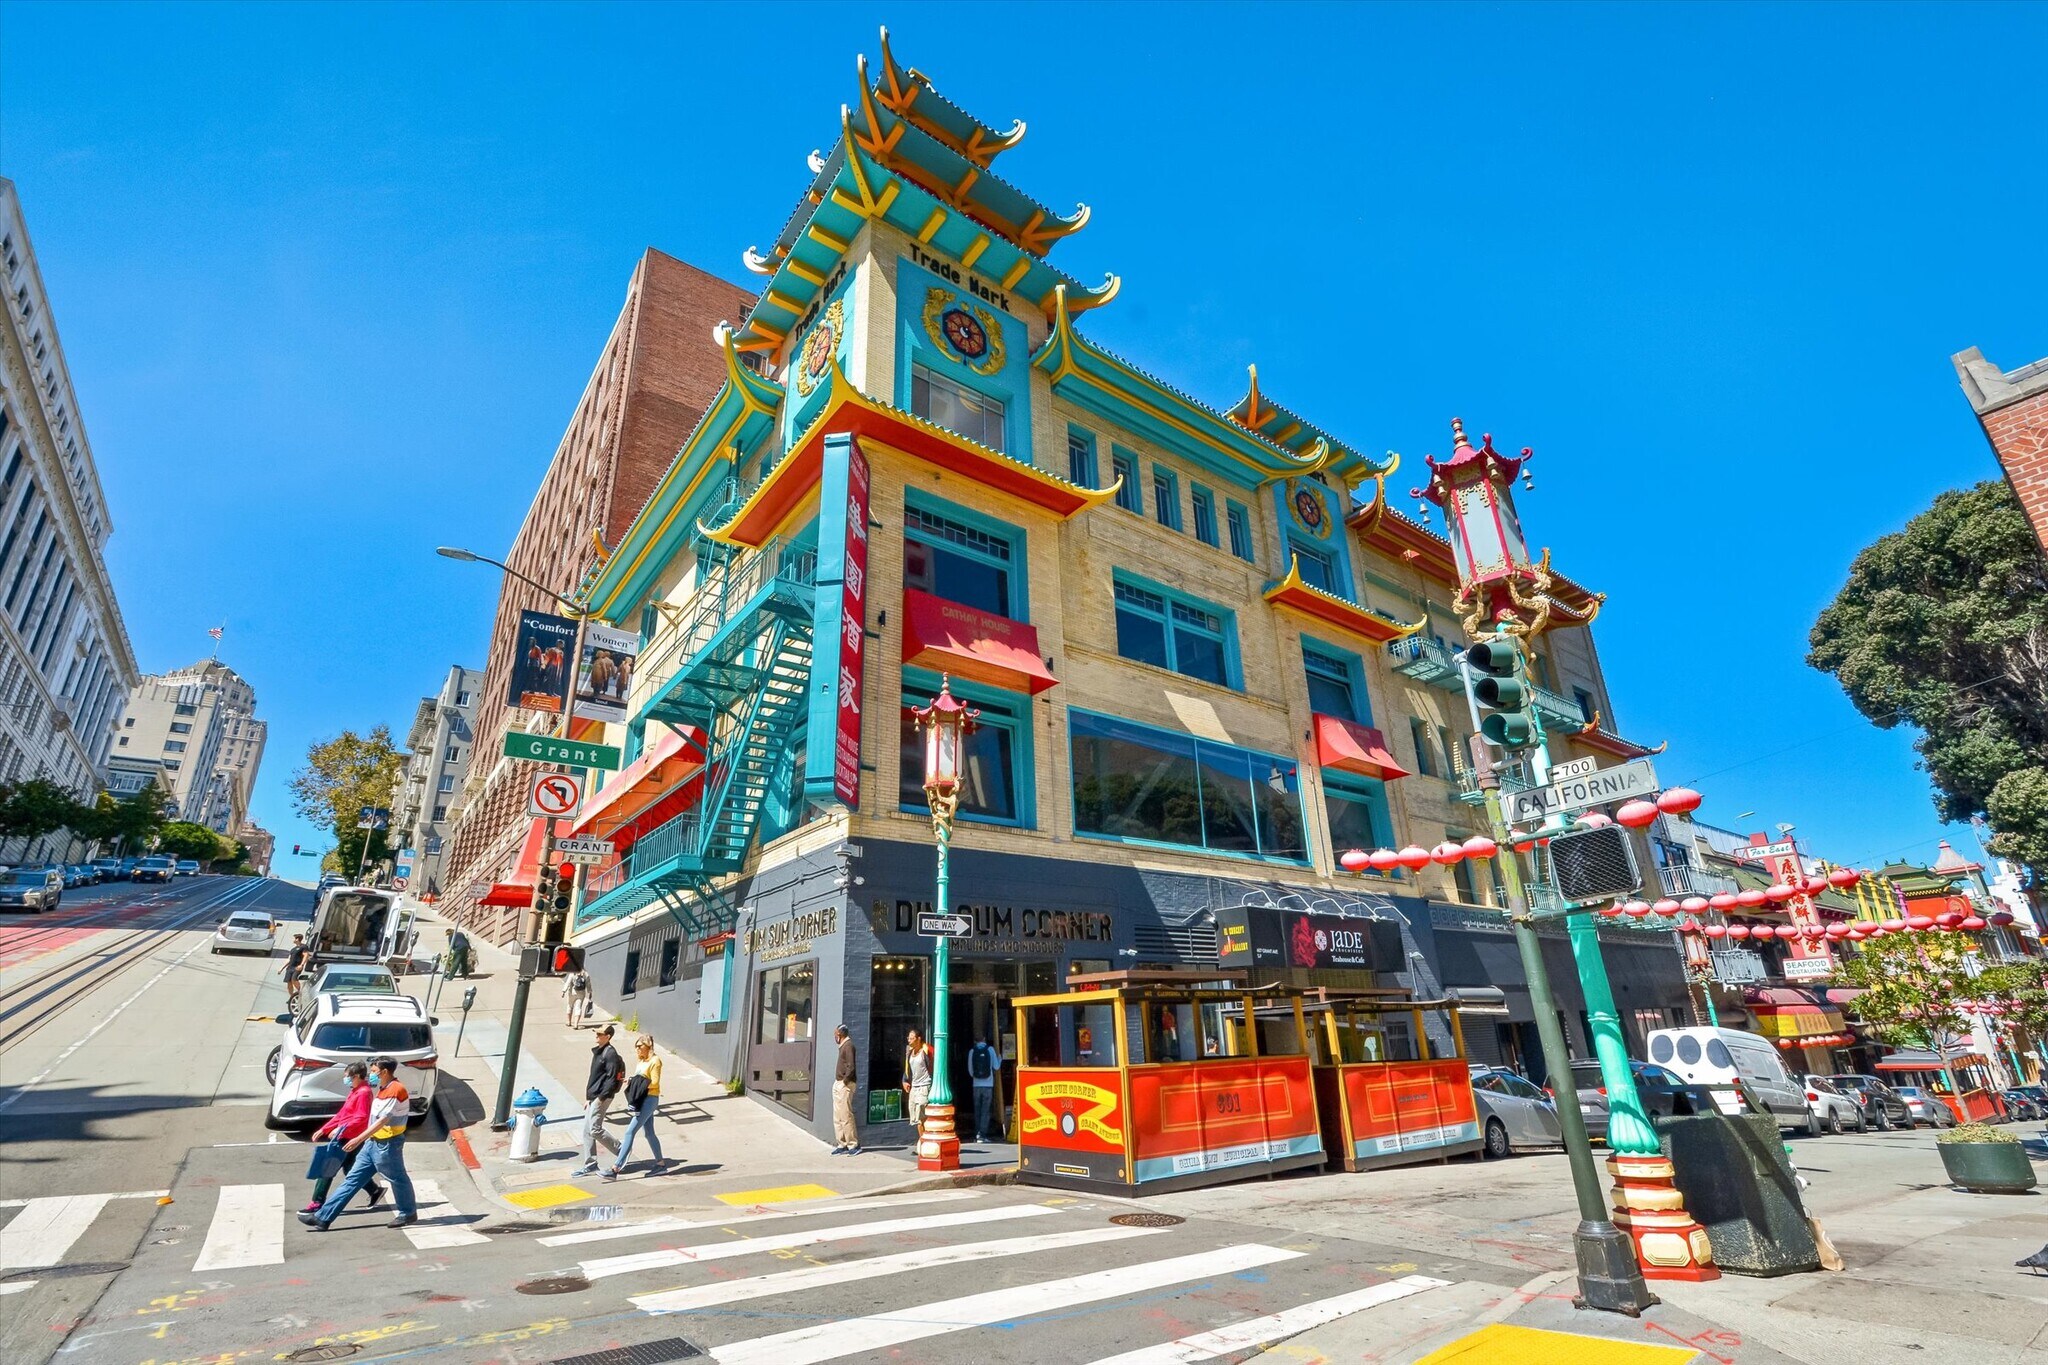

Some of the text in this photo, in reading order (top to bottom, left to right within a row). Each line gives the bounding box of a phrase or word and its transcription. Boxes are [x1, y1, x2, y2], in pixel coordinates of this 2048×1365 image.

[909, 243, 1010, 311] Trade Mark
[795, 261, 847, 341] Trade Mark
[942, 606, 977, 624] CATHAY
[981, 616, 1011, 634] HOUSE
[530, 741, 598, 762] Grant
[1562, 760, 1590, 776] 700
[1518, 773, 1642, 814] CALIFORNIA
[560, 841, 610, 852] GRANT
[1750, 845, 1790, 856] Far East
[768, 919, 790, 946] SUM
[792, 907, 837, 943] CORNER
[923, 920, 957, 930] ONE WAY
[1022, 908, 1113, 941] CORNER
[1785, 960, 1827, 969] SEAFOOD
[1040, 1084, 1097, 1099] DIM SUM CORNER
[1080, 1118, 1099, 1132] GRANT
